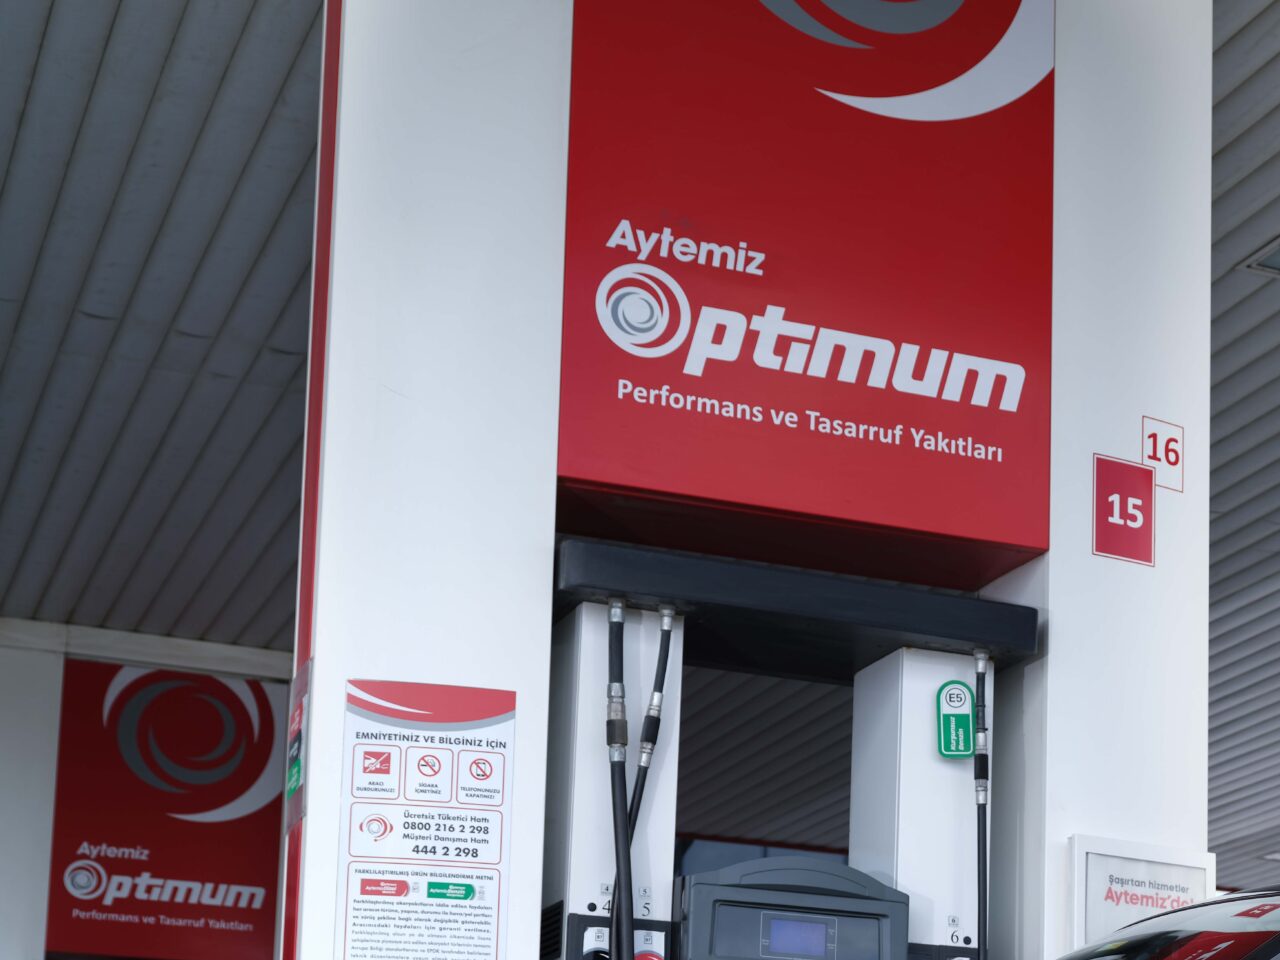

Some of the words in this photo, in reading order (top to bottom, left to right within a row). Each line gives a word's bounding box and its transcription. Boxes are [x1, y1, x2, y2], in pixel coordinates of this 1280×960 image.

[605, 218, 766, 277] Aytemiz
[616, 378, 763, 423] Performans
[770, 407, 799, 428] ve
[805, 409, 903, 446] Tasarruf
[909, 426, 1003, 463] Yakıtları
[1147, 432, 1180, 467] 16
[1107, 493, 1144, 530] 15
[948, 693, 962, 702] E5
[355, 731, 420, 742] EMNİYETİNİZ
[424, 736, 436, 744] VE
[439, 735, 482, 747] BİLGİNİZ
[486, 738, 507, 750] İÇİN
[404, 812, 435, 820] Ücretsiz
[438, 813, 468, 822] Tüketici
[403, 822, 431, 831] 0800
[435, 823, 455, 832] 216
[469, 825, 489, 834] 298
[402, 833, 432, 842] Müşteri
[77, 841, 150, 860] Aytemiz
[412, 845, 437, 855] 444
[442, 846, 450, 856] 2
[454, 847, 478, 858] 298
[1108, 874, 1146, 888] Şaşırtan
[1148, 880, 1189, 894] hizmetler
[602, 900, 612, 914] 4
[642, 902, 651, 917] 5
[72, 908, 140, 924] Performans
[142, 916, 155, 924] ve
[159, 915, 204, 928] Tasarruf
[951, 930, 959, 944] 6
